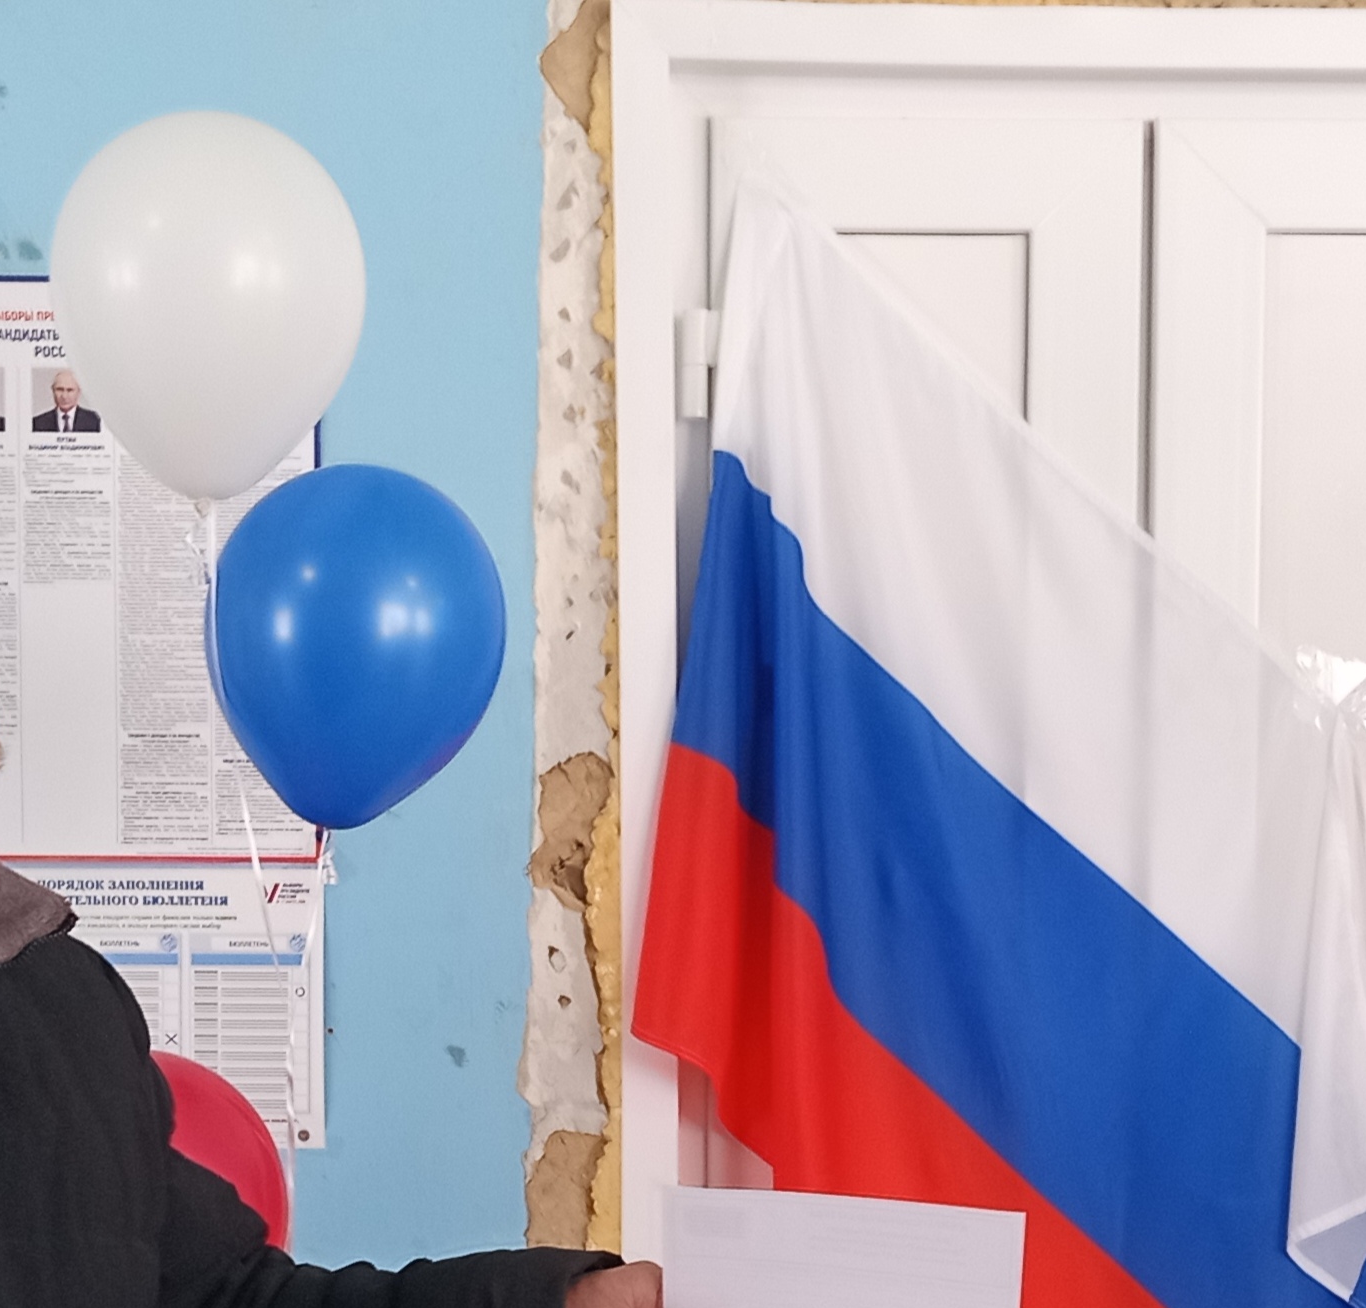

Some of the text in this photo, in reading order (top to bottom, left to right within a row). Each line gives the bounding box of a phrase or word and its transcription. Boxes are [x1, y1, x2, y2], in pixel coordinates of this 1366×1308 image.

[108, 880, 204, 891] ЗАПОЛНЕНИЯ
[66, 895, 229, 907] ТЕЛЬНОГО БЮЛЛЕТЕНЯ
